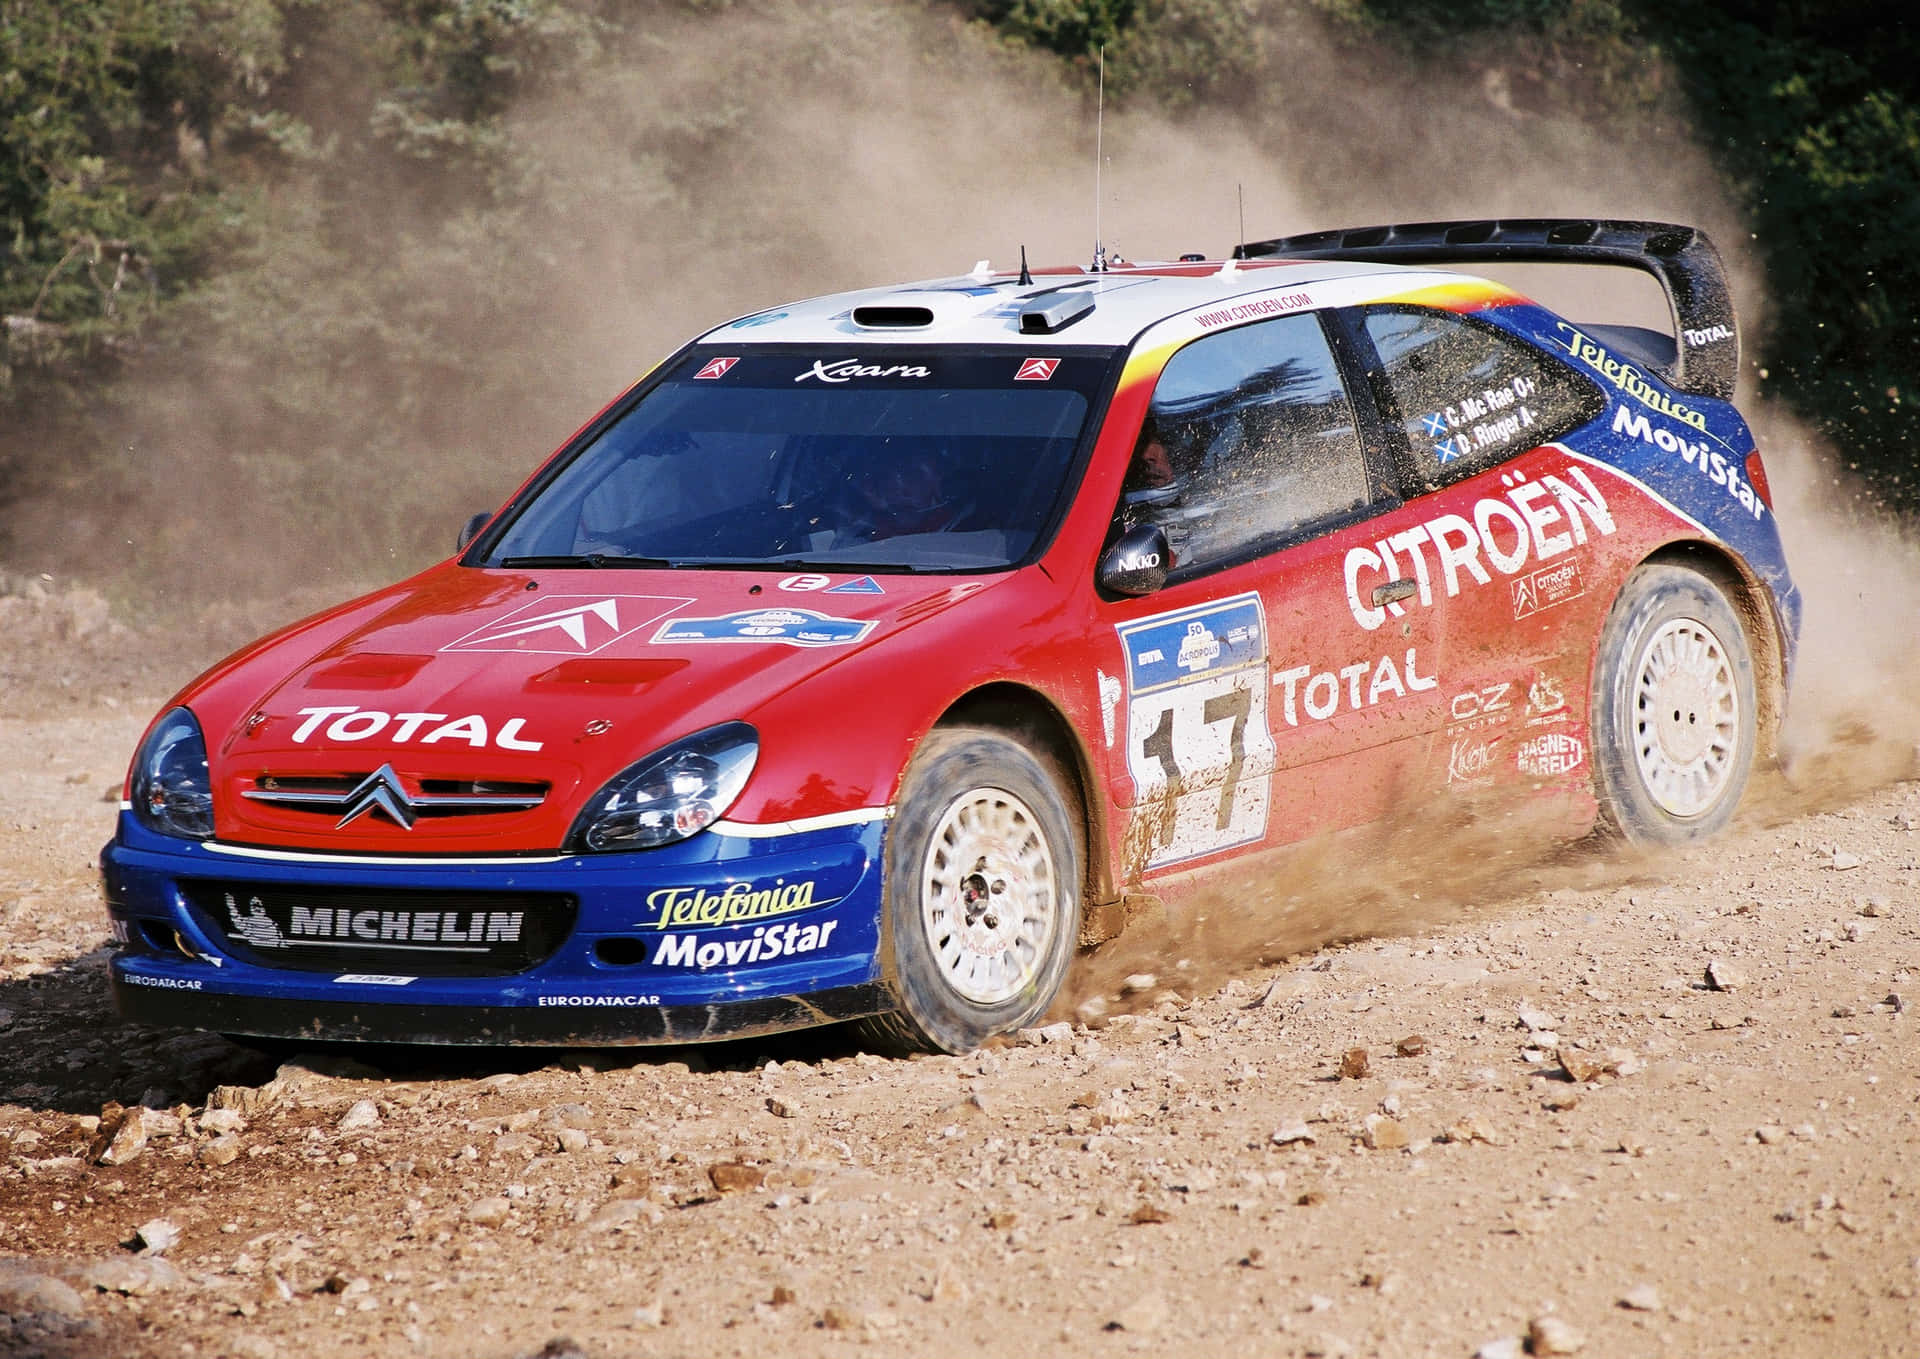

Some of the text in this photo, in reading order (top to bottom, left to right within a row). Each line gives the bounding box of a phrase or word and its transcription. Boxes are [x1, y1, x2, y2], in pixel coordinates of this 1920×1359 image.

[1194, 293, 1313, 327] WWW.CITROEN.COM
[1684, 325, 1734, 346] TOTAL
[795, 358, 931, 382] Xsara
[1612, 404, 1765, 520] MoviStar
[1118, 553, 1160, 572] NIKKO
[1344, 466, 1617, 631] CITROËN
[787, 576, 822, 589] E
[1190, 625, 1202, 636] 50
[1179, 645, 1218, 663] ACROPOLIS
[1273, 648, 1437, 727] TOTAL
[1452, 682, 1511, 719] OZ
[291, 706, 544, 752] TOTAL
[1143, 687, 1252, 847] 17
[290, 906, 524, 941] MICHELIN
[652, 920, 838, 967] MoviStar
[124, 974, 203, 990] EURODATACAR
[538, 995, 661, 1007] EURODATACAR
